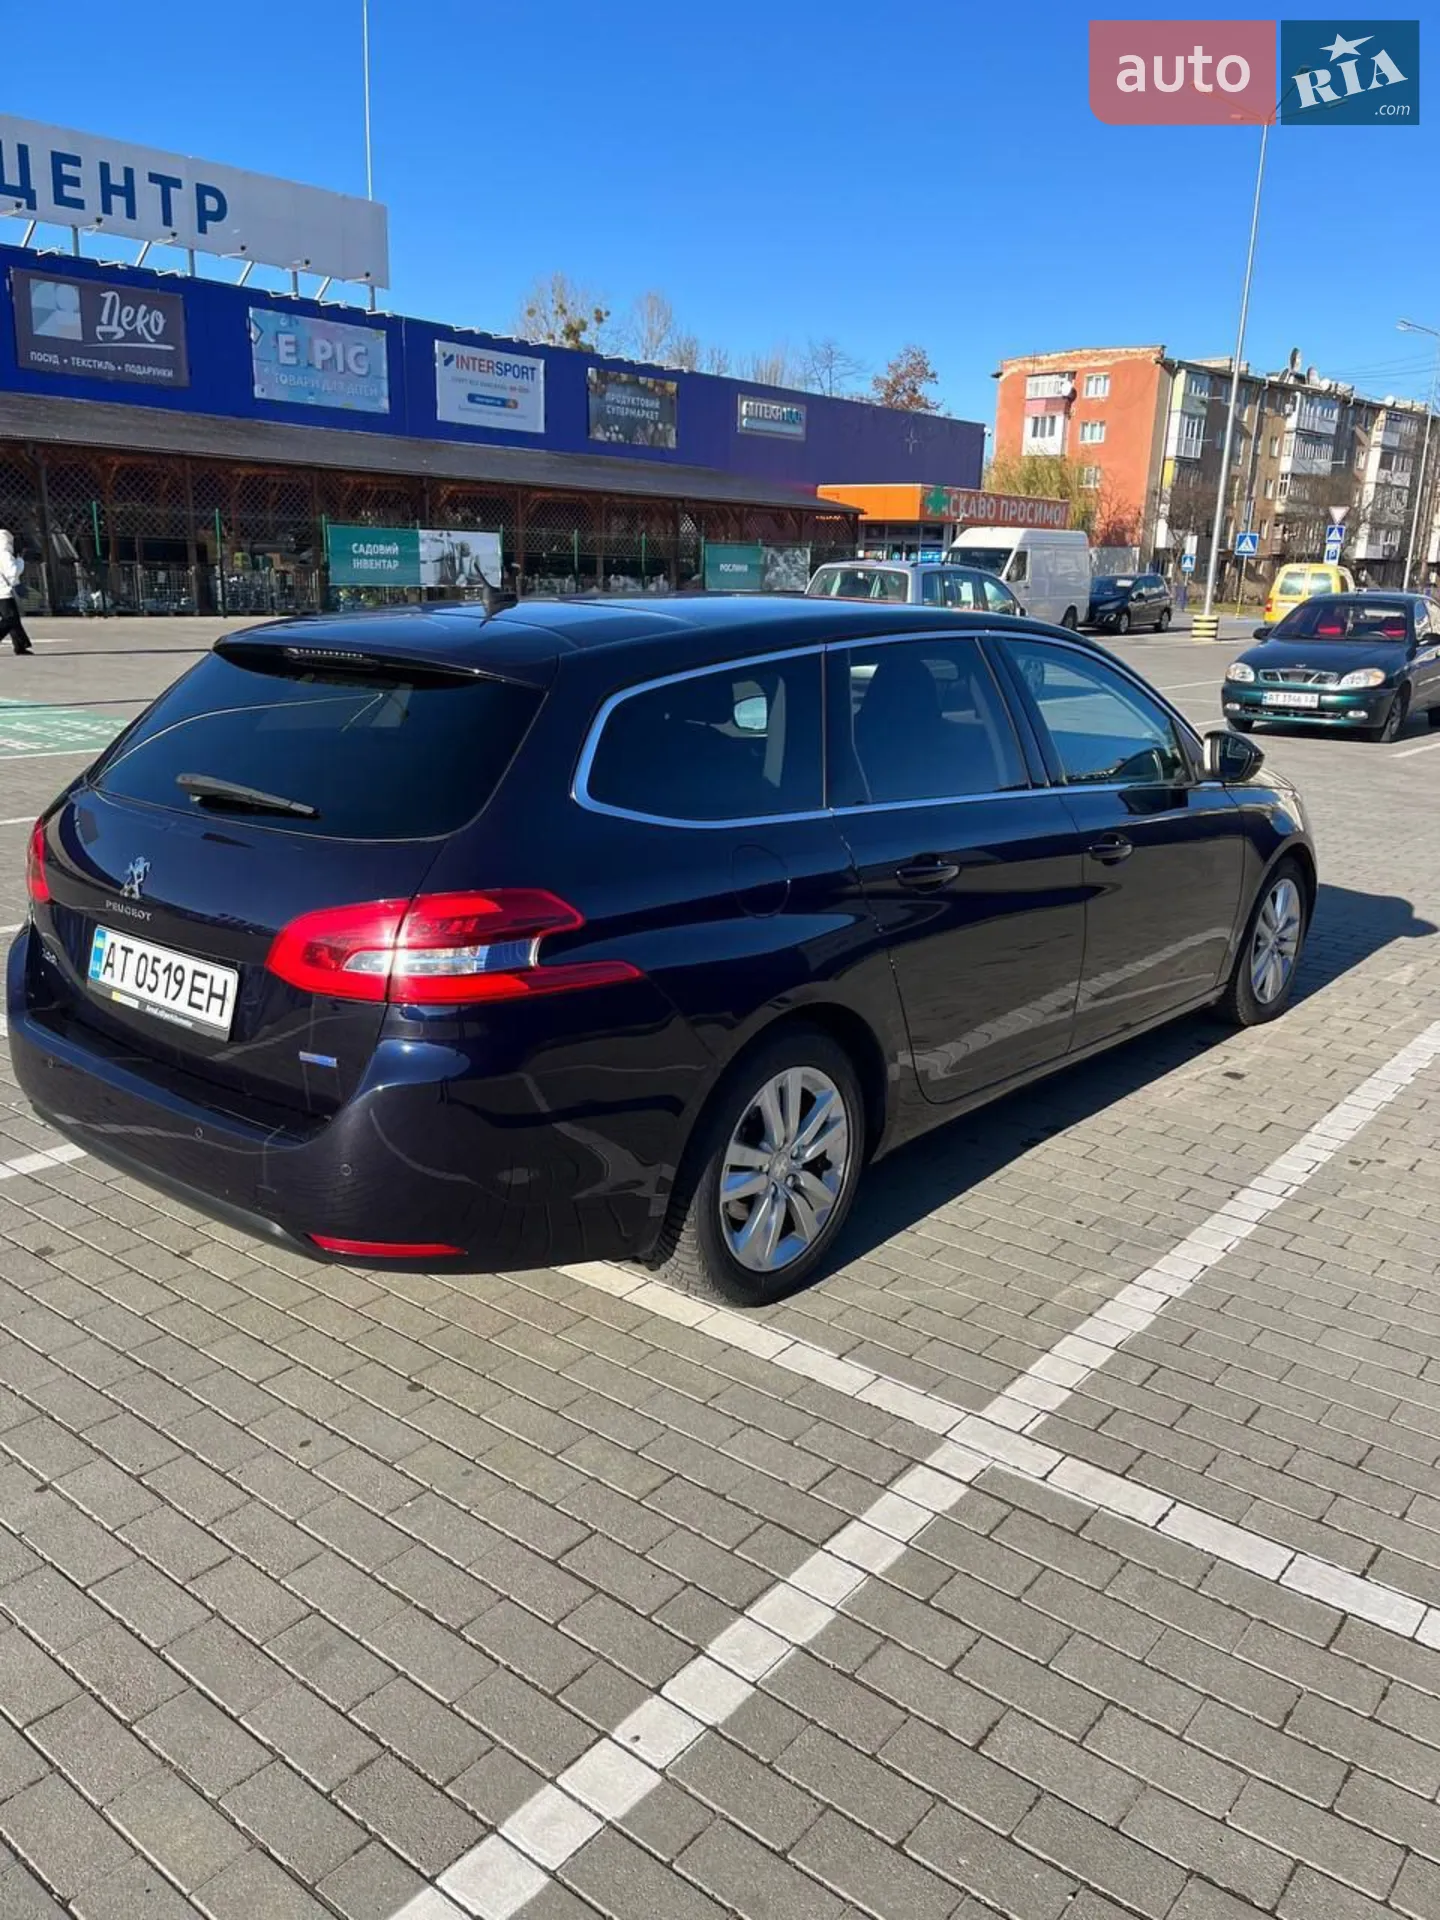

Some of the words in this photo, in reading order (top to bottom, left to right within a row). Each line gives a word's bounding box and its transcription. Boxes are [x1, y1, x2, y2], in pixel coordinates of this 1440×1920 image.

[0, 138, 228, 235] ЦЕНТР
[95, 290, 167, 343] Деко
[30, 351, 60, 365] ПОСУД
[71, 356, 116, 372] ТЕКСТИЛЬ
[455, 354, 537, 382] INTERSPORT
[606, 405, 659, 420] СУПЕРМАРКЕТ
[1000, 500, 1066, 525] ПРОСИМО!
[352, 542, 399, 556] САДОВИЙ
[353, 559, 399, 570] ІНВЕНТАР
[106, 900, 152, 921] PEUGEOT
[102, 941, 134, 983] AT
[135, 952, 186, 1001] 0519
[187, 969, 229, 1018] EH
